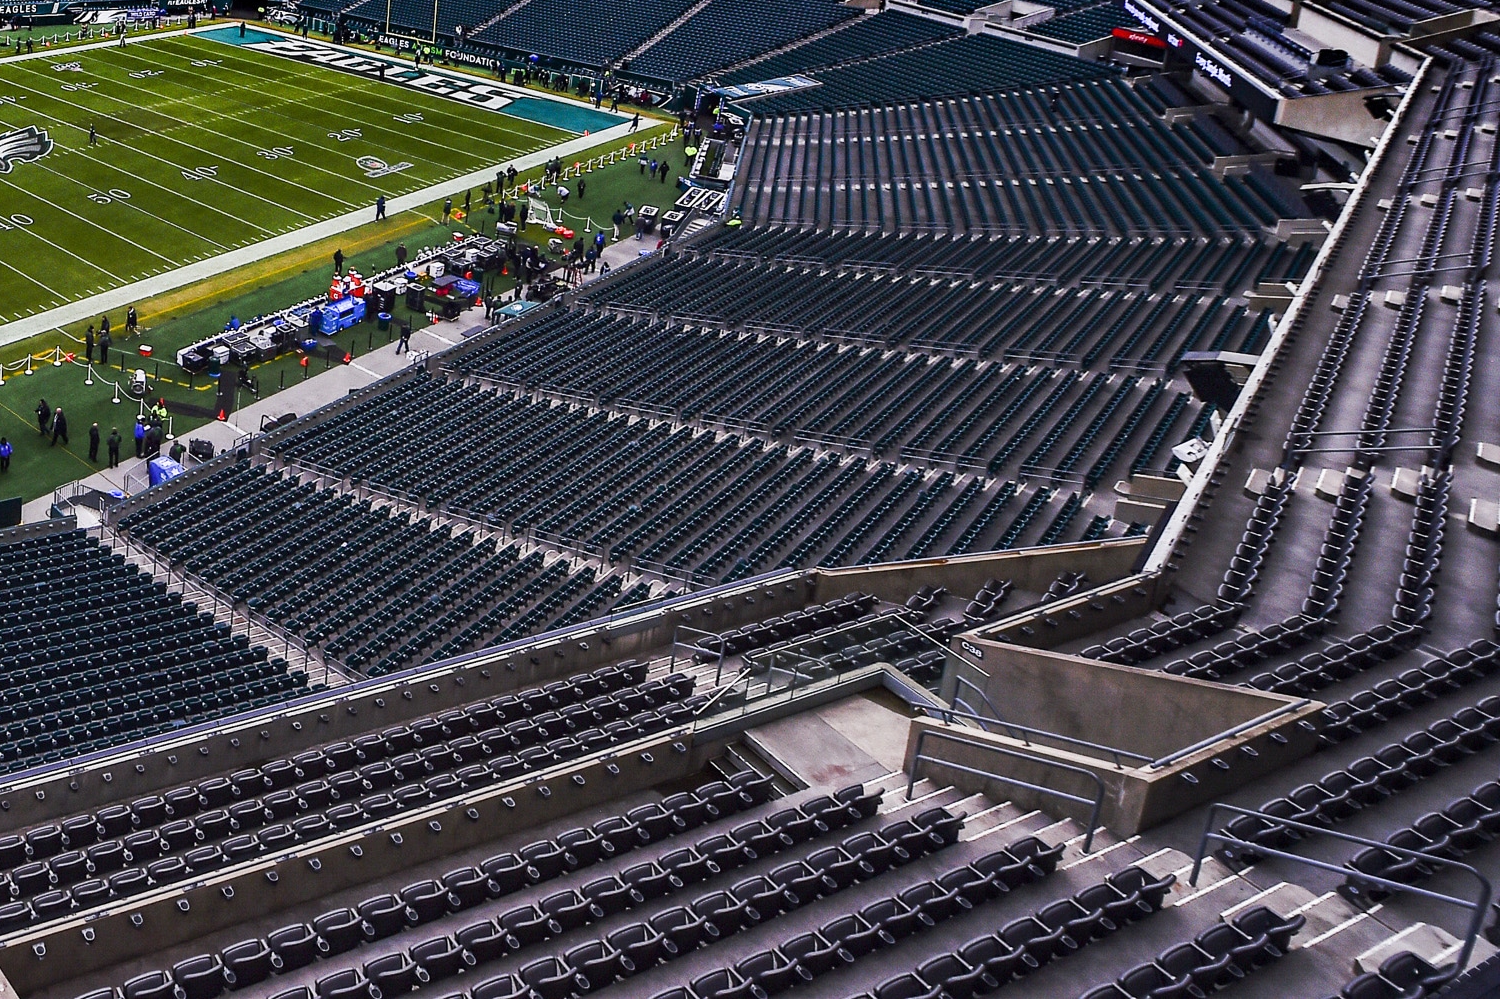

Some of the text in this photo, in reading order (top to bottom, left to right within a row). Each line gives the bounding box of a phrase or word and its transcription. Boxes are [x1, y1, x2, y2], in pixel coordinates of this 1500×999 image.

[0, 4, 37, 14] EAGLES
[379, 35, 409, 48] EAGLES
[190, 59, 217, 68] 10
[129, 69, 158, 79] 20
[241, 37, 543, 110] EAGLES
[393, 113, 424, 124] 10
[327, 129, 362, 142] 20
[256, 146, 294, 160] 30
[181, 166, 217, 182] 40
[87, 188, 132, 204] 50
